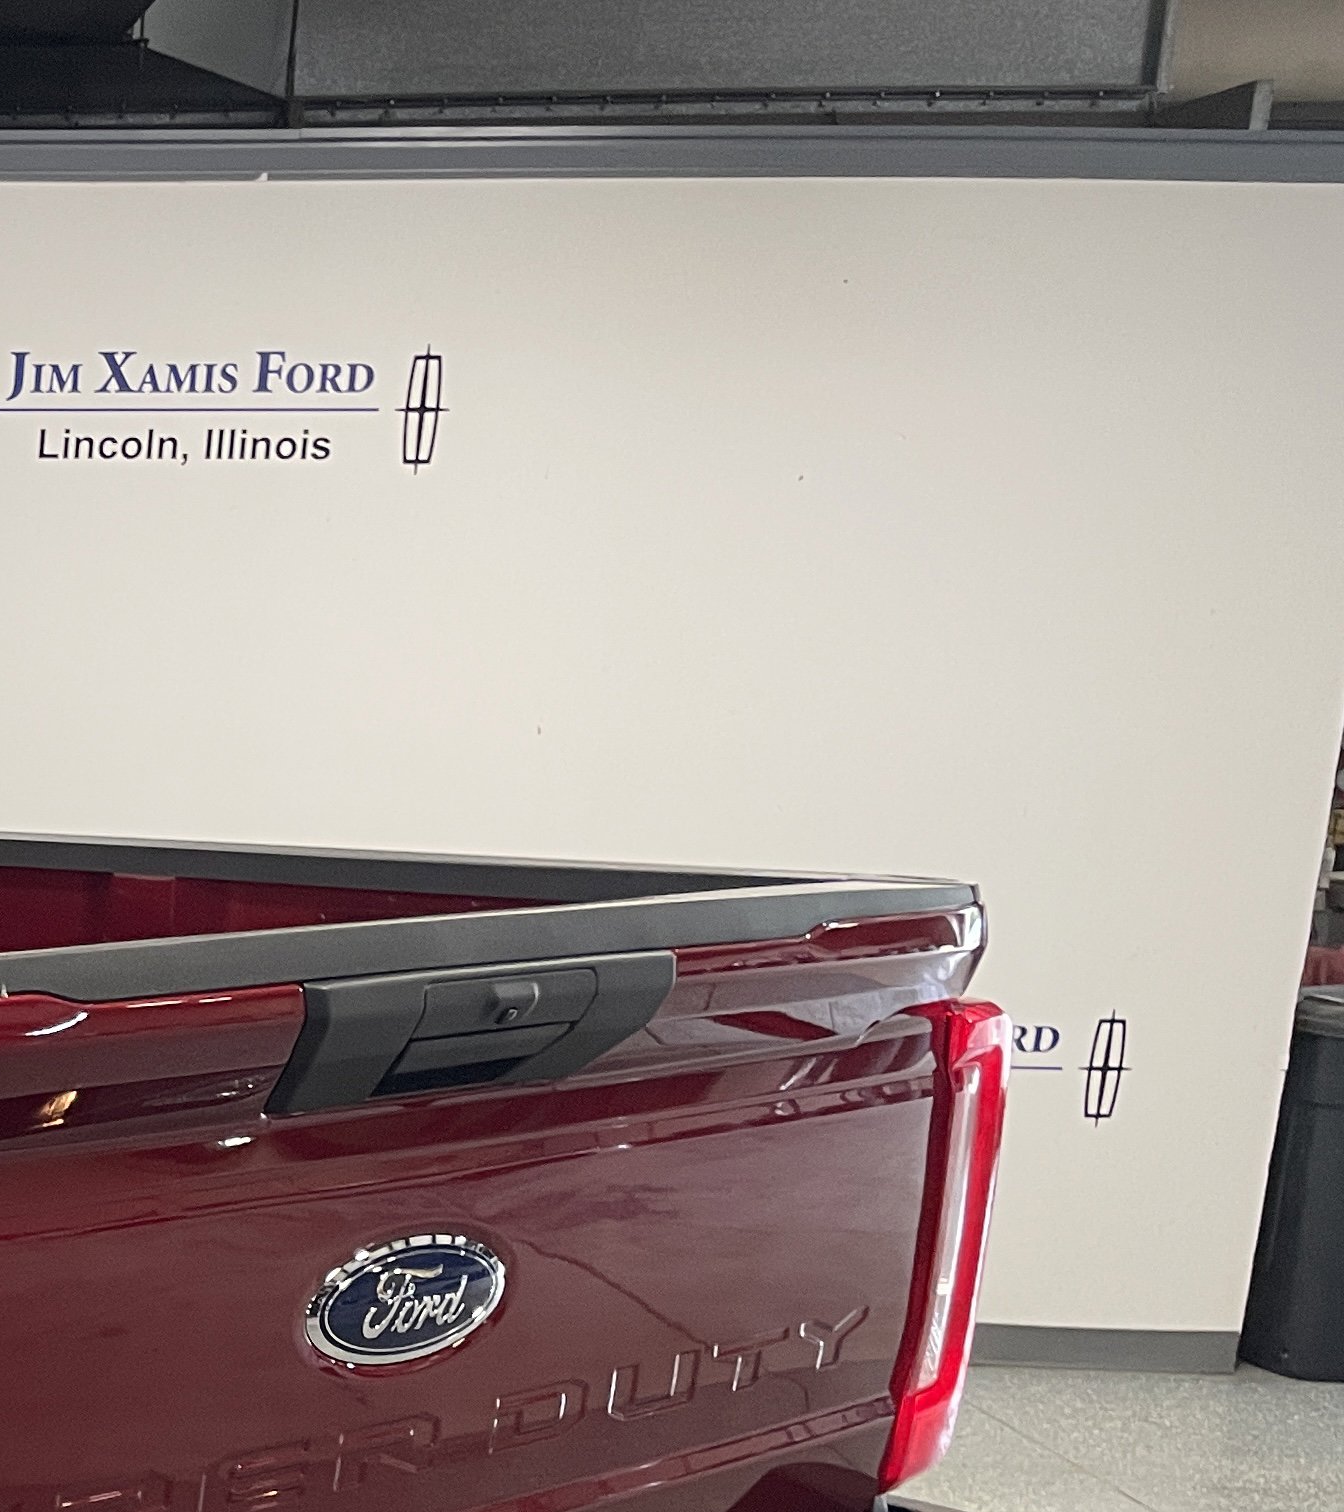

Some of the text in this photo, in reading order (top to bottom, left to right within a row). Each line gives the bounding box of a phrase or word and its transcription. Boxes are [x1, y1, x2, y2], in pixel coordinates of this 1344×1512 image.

[6, 351, 375, 401] JIM XAMIS FORD
[38, 428, 331, 465] Lincoln, Illinois
[485, 1305, 871, 1457] DUTY
